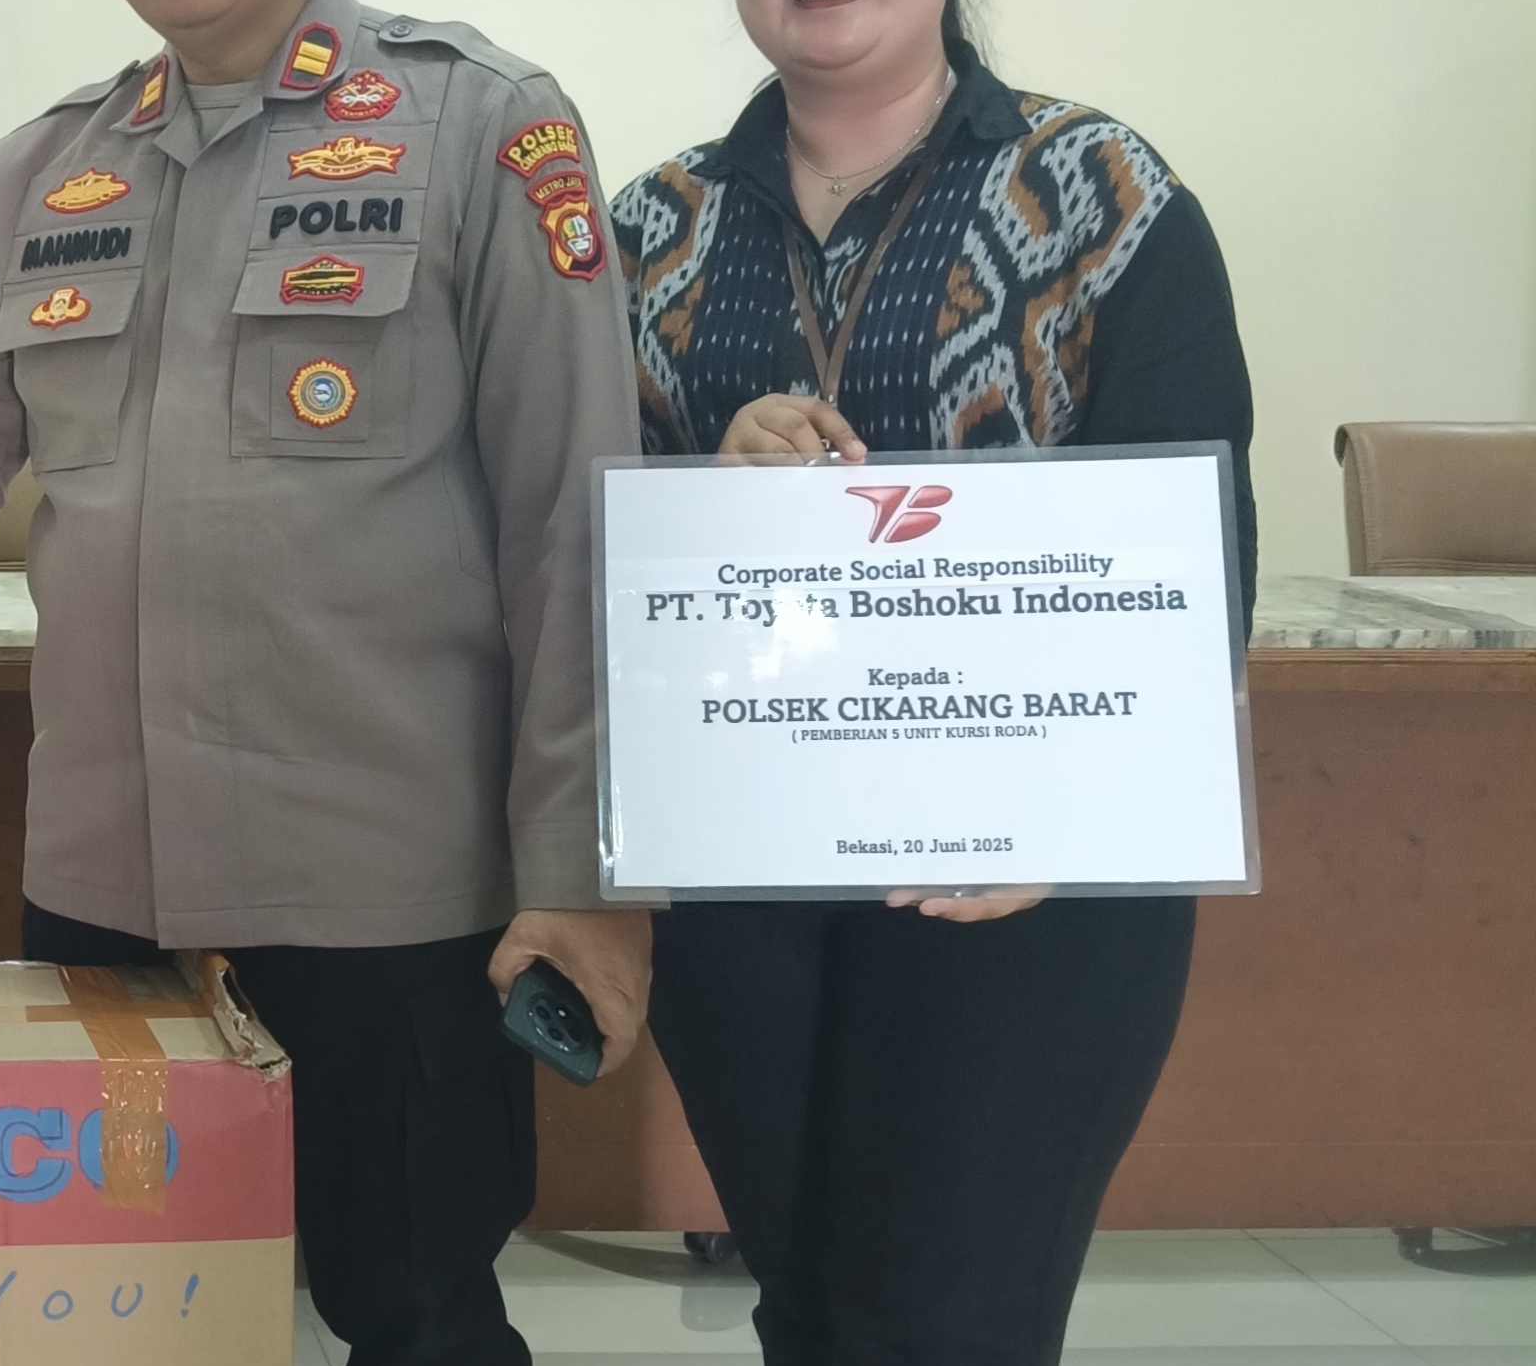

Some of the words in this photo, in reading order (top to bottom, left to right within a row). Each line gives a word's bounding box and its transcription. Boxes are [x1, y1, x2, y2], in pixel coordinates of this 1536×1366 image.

[508, 125, 575, 163] POLSEK
[535, 178, 564, 199] METRO
[270, 198, 404, 239] POLRI
[20, 227, 132, 272] MAHMUDI
[718, 564, 842, 588] Corporate
[850, 559, 925, 581] Social
[933, 553, 1114, 581] Responsibility
[646, 593, 704, 621] PT.
[849, 588, 1001, 617] Boshoku
[1013, 583, 1187, 614] Indonesia
[867, 667, 950, 690] Kepada
[702, 698, 829, 724] POLSEK
[837, 693, 1013, 722] CIKARANG
[1022, 691, 1137, 717] BARAT
[801, 728, 887, 741] PEMBERIAN
[892, 728, 900, 740] 5
[904, 727, 941, 740] UNIT
[945, 726, 990, 738] KURSI
[994, 725, 1038, 737] RODA
[836, 839, 898, 856] Bekasi,
[903, 839, 924, 854] 20
[929, 838, 967, 853] Juni
[972, 837, 1013, 852] 2025
